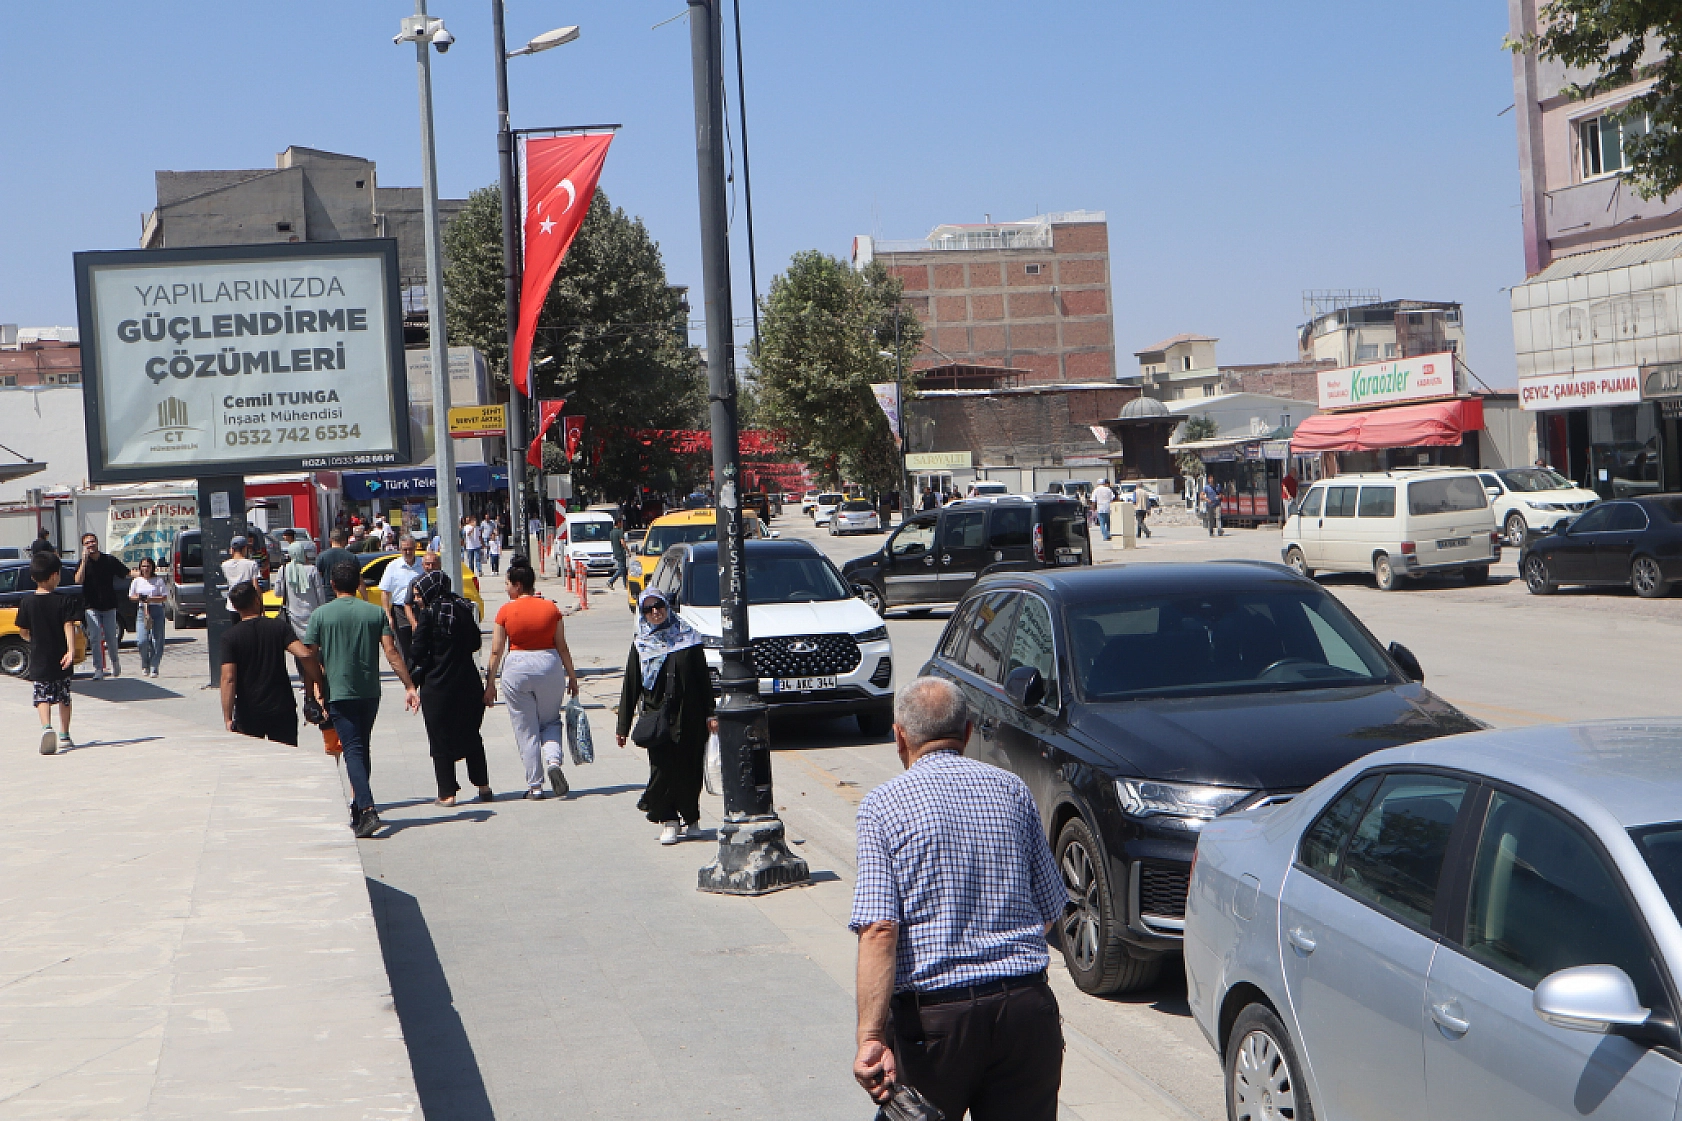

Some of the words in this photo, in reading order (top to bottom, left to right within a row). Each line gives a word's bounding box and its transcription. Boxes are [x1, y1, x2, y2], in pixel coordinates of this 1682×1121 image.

[134, 276, 346, 306] YAPILARINIZDA
[117, 305, 367, 345] GÜÇLENDİRME
[145, 341, 346, 384] ÇÖZÜMLERİ
[1351, 363, 1410, 402] Karaözler
[223, 393, 273, 409] Cemil
[276, 389, 340, 405] TUNGA
[223, 411, 266, 426] İnşaat
[270, 406, 343, 422] Mühendisi
[164, 430, 184, 444] CT
[225, 429, 272, 447] 0532
[277, 426, 310, 443] 742
[315, 422, 362, 441] 6534
[383, 479, 409, 491] Türk
[412, 476, 462, 489] Telem
[111, 506, 136, 521] İLGİ
[139, 503, 195, 517] İLETİŞİM
[122, 525, 175, 547] TEKNİ
[123, 547, 169, 562] SERV
[780, 679, 791, 690] 34
[817, 677, 835, 688] 344
